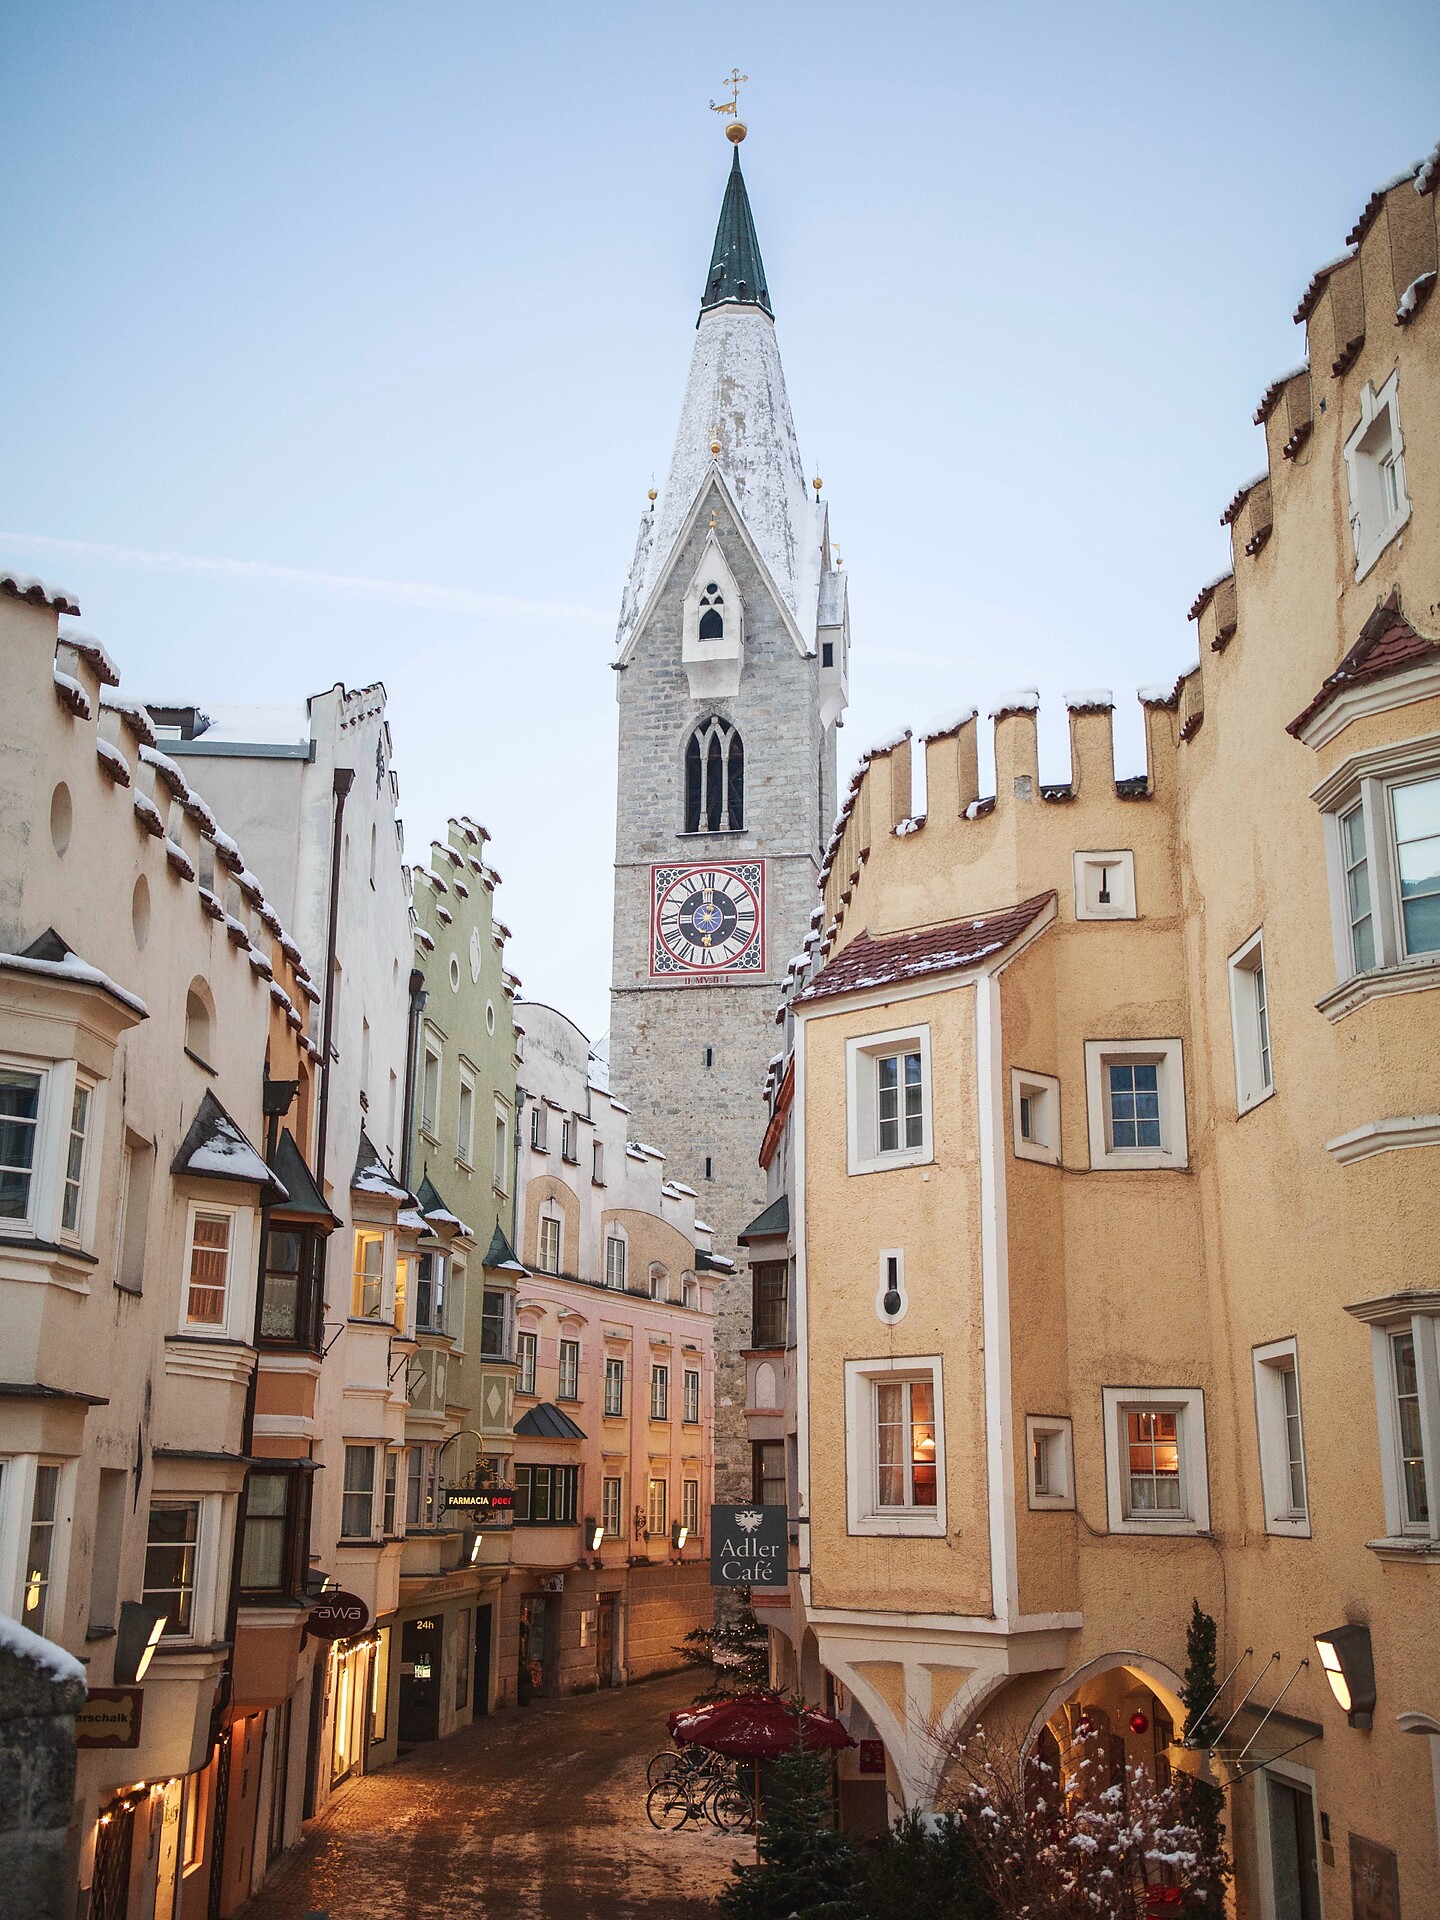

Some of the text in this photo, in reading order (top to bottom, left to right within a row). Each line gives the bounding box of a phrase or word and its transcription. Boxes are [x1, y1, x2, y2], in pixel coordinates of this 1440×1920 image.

[700, 873, 716, 889] XII
[732, 889, 750, 904] II
[738, 910, 755, 921] III
[448, 1496, 512, 1507] FARMACIA peer
[719, 1537, 780, 1557] Adler
[722, 1560, 773, 1581] Café
[416, 1620, 435, 1630] 24h
[75, 1713, 128, 1723] arschalk
